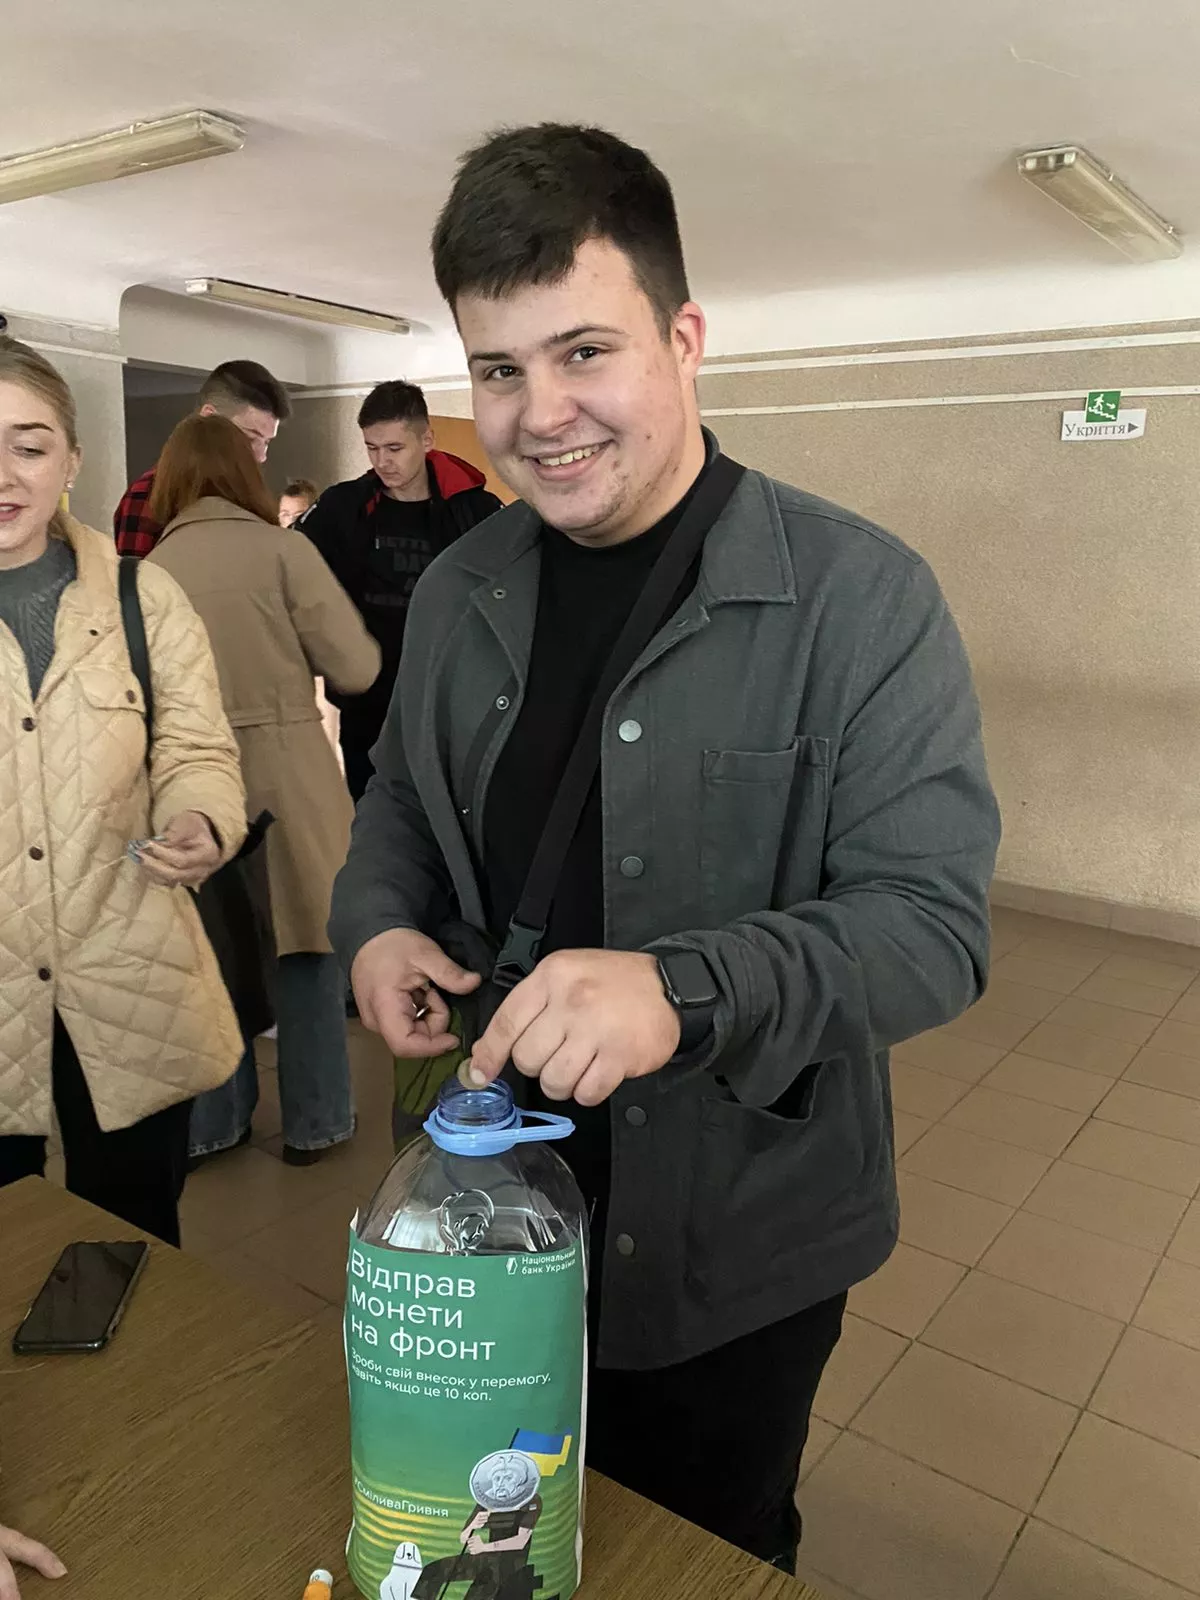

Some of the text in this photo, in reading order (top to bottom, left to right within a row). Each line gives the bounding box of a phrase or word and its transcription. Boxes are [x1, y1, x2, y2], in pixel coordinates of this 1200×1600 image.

[1065, 423, 1125, 437] Укриття
[351, 1249, 476, 1299] Відправ
[522, 1266, 543, 1275] банк
[351, 1285, 463, 1329] монети
[351, 1314, 496, 1361] на фронт
[385, 1367, 412, 1380] свій
[417, 1370, 465, 1387] внесок
[469, 1377, 479, 1389] у
[385, 1380, 420, 1395] якщо
[424, 1385, 440, 1399] це
[445, 1387, 459, 1400] 10
[463, 1391, 492, 1401] коп.
